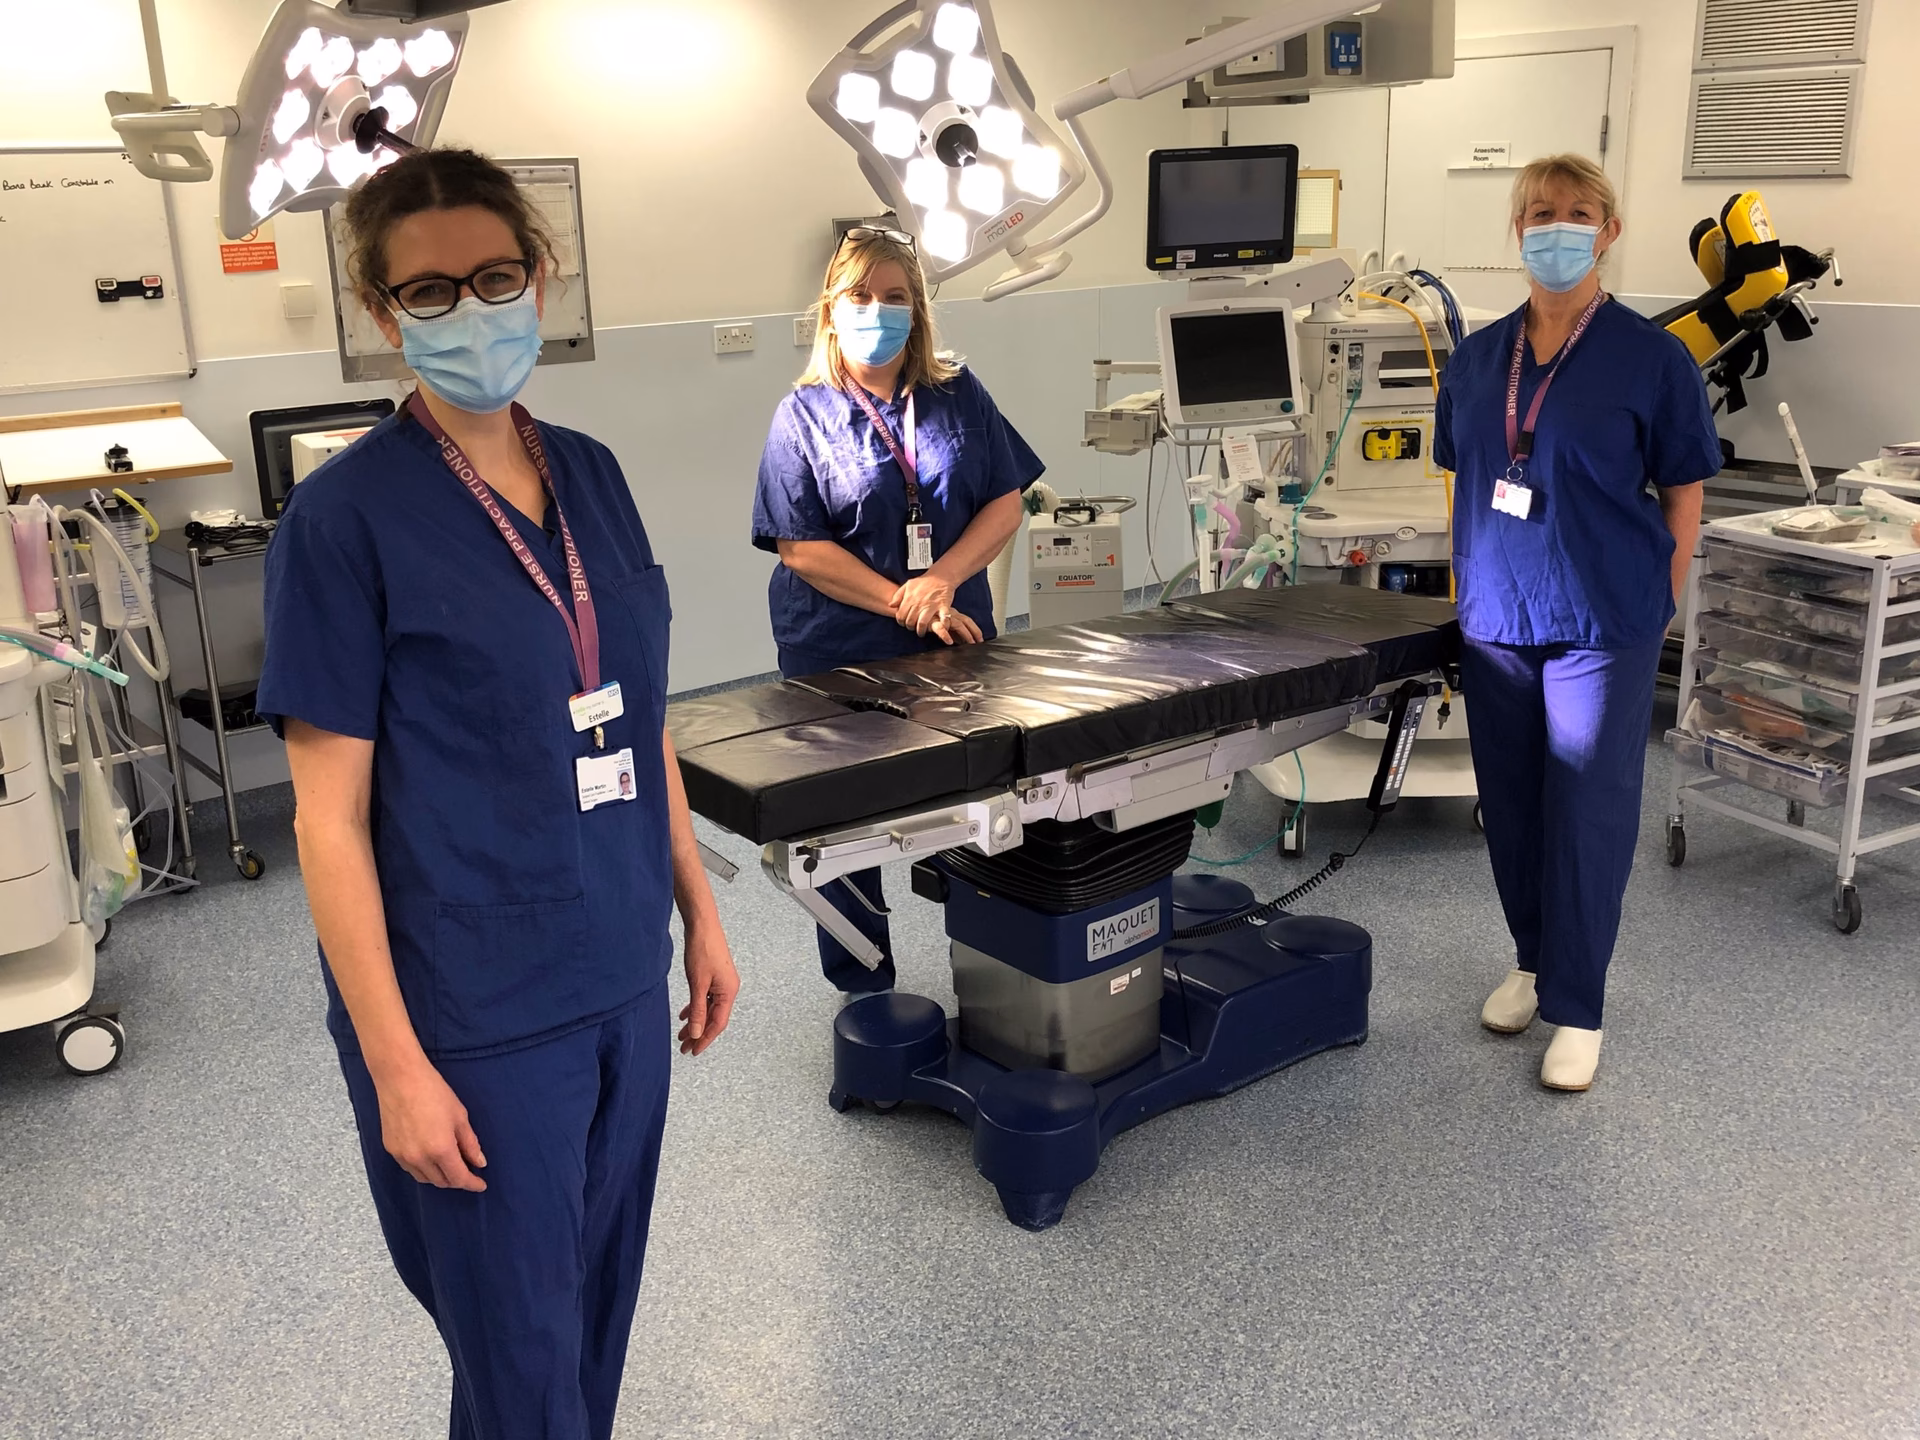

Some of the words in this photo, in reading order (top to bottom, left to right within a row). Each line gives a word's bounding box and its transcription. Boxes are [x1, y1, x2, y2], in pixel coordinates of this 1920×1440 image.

[1507, 350, 1523, 416] PRACTITIONER
[520, 424, 549, 480] NURSE
[875, 421, 897, 450] NURSE
[521, 551, 562, 606] NURSE
[1106, 554, 1115, 566] 1
[588, 709, 610, 723] Estelle
[1092, 904, 1156, 943] MAQUET
